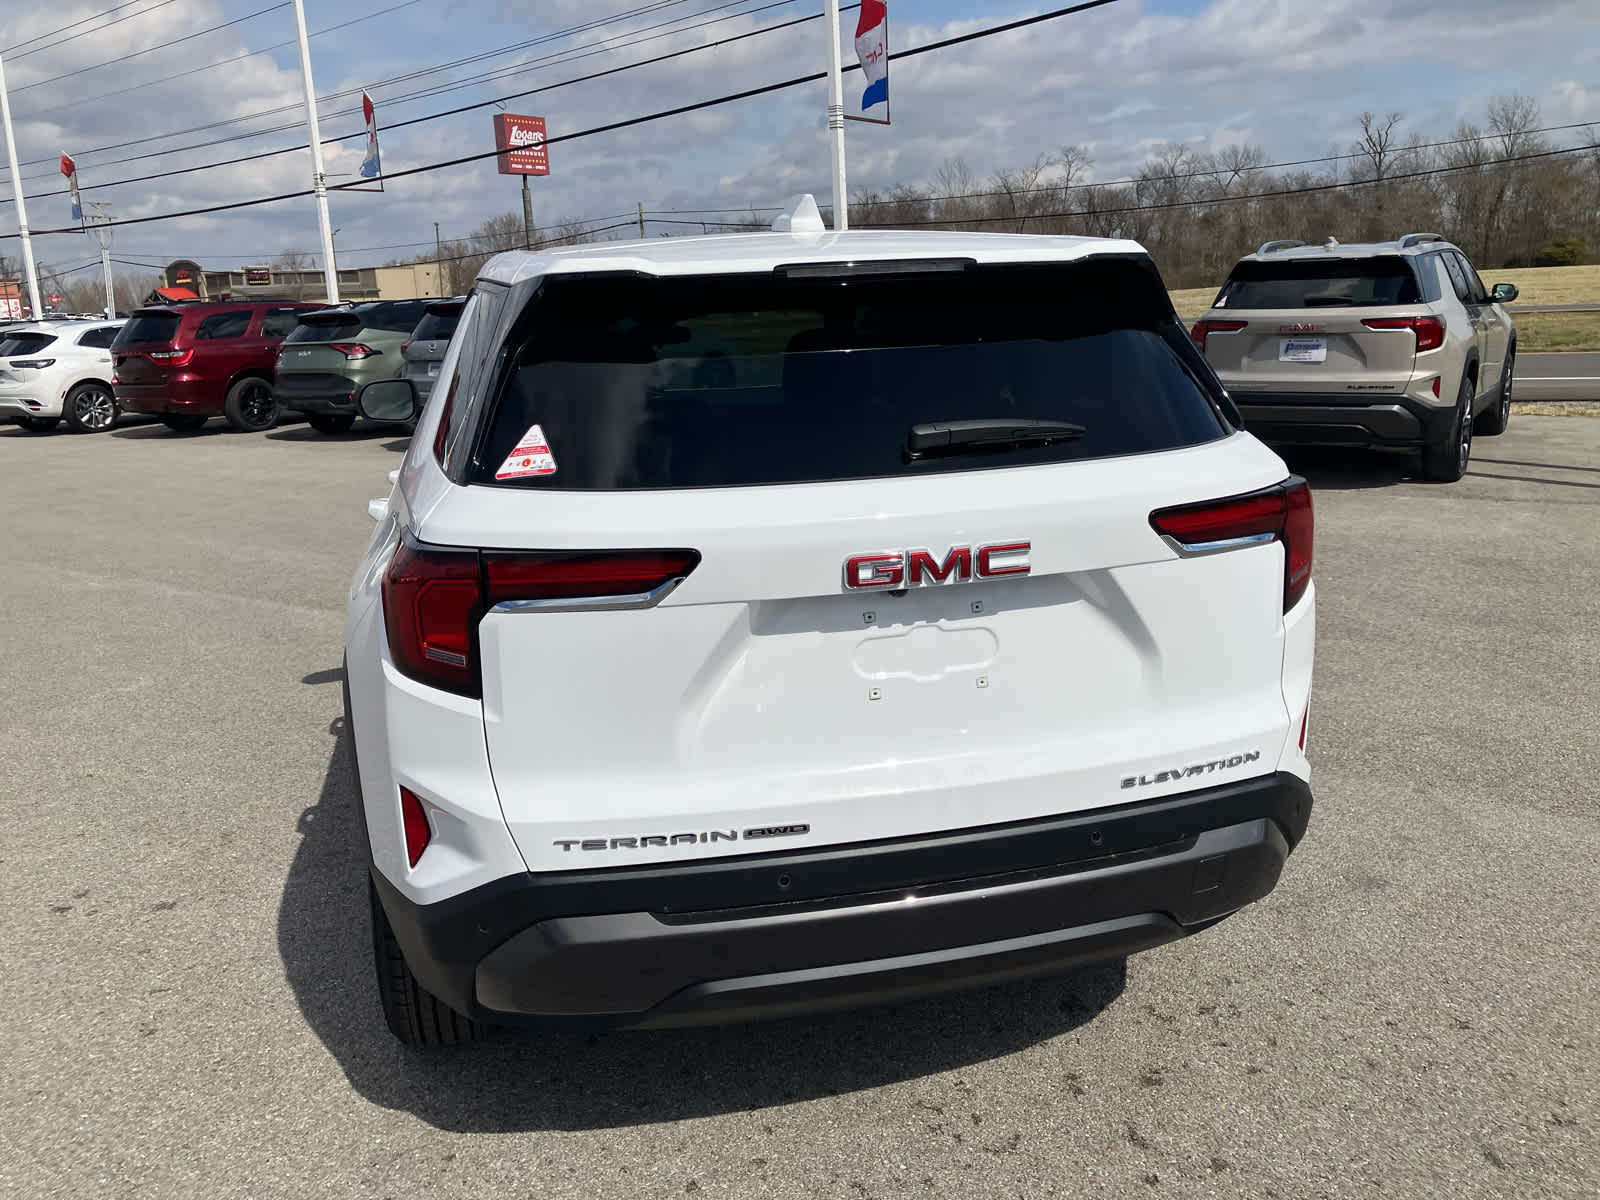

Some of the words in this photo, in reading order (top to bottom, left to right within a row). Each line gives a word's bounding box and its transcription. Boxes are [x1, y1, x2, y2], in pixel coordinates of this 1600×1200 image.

[842, 538, 1031, 592] GMC
[1120, 750, 1260, 789] ELEVATION
[553, 829, 738, 852] TERRAIN
[744, 823, 811, 840] AWD
